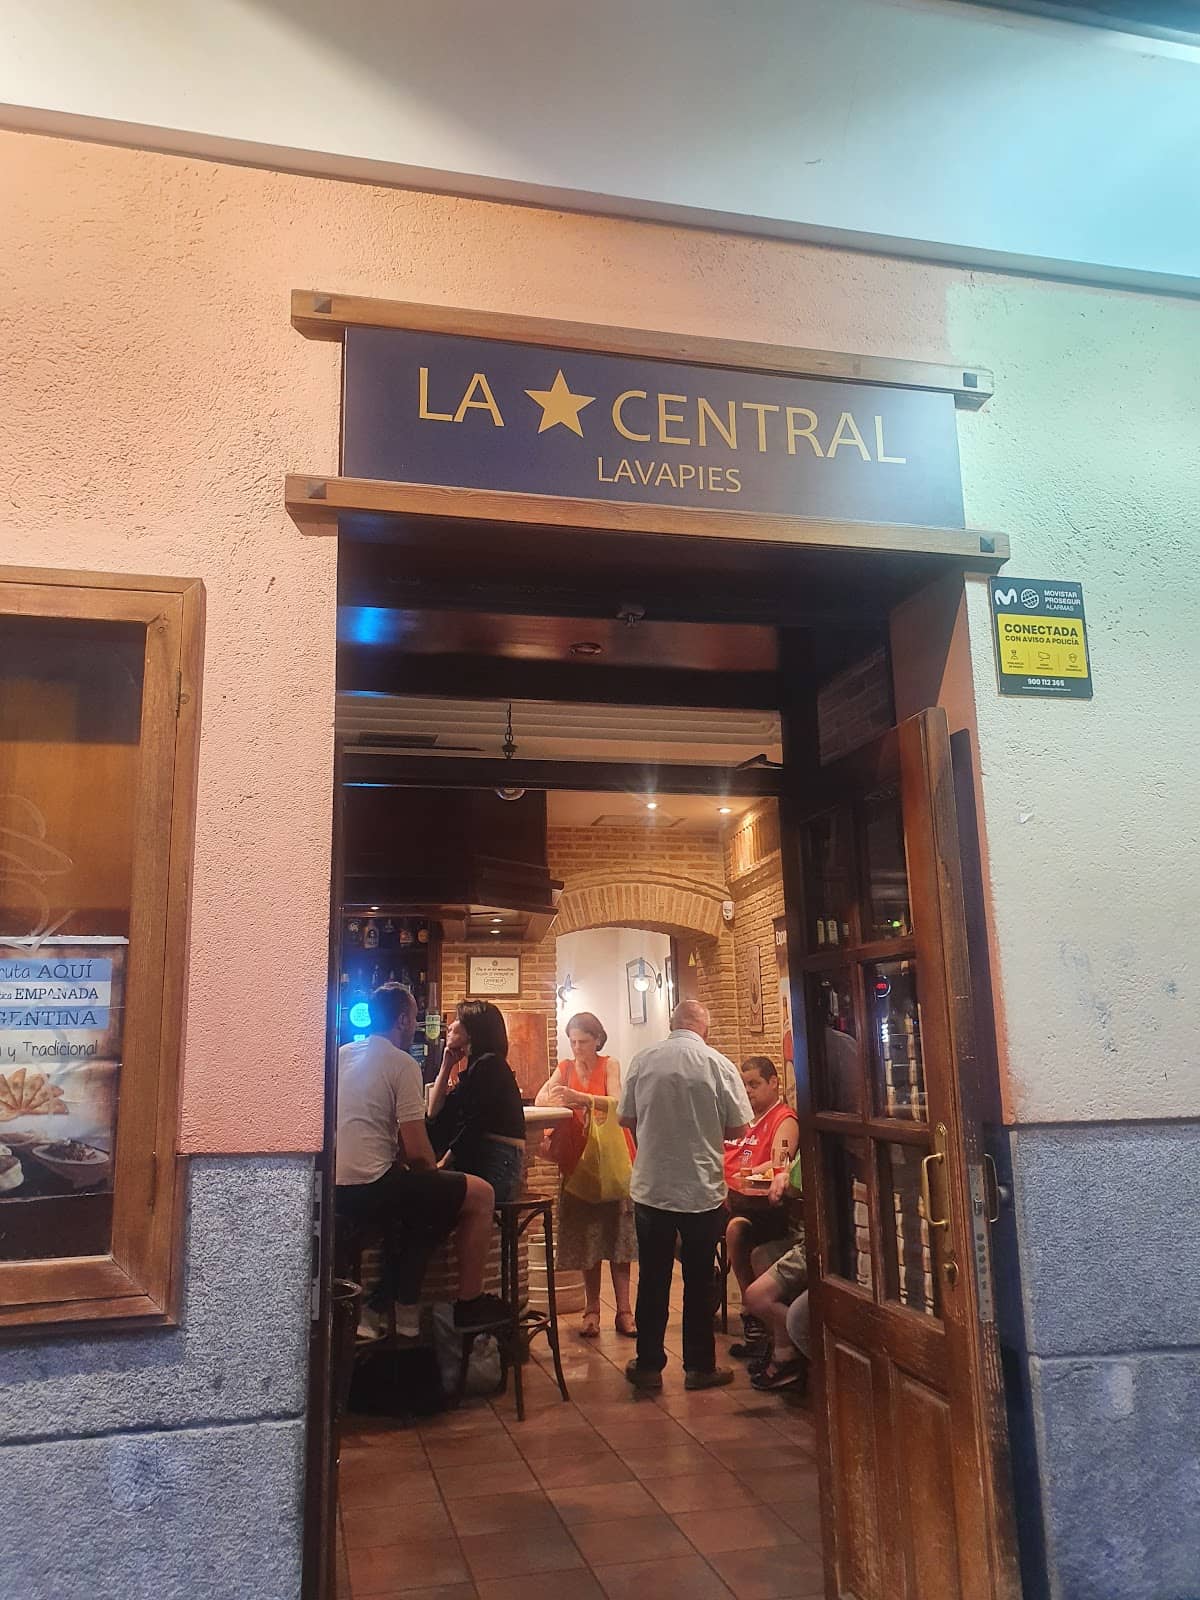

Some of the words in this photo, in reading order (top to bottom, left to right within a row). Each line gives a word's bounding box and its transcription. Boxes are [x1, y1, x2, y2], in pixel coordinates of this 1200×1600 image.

[418, 367, 505, 427] LA
[611, 389, 907, 465] CENTRAL
[597, 456, 742, 494] LAVAPIES
[1043, 590, 1078, 599] MOVISTAR
[1044, 597, 1081, 606] PROSEGUR
[1045, 604, 1075, 612] ALARMAS
[1004, 623, 1079, 638] CONECTADA
[1022, 636, 1045, 644] AVISO
[1052, 638, 1080, 646] POLICÍA
[37, 960, 93, 979] AQUÍ
[14, 987, 99, 1000] EMPANADA
[7, 1046, 17, 1062] y
[22, 1040, 98, 1057] Tradicional
